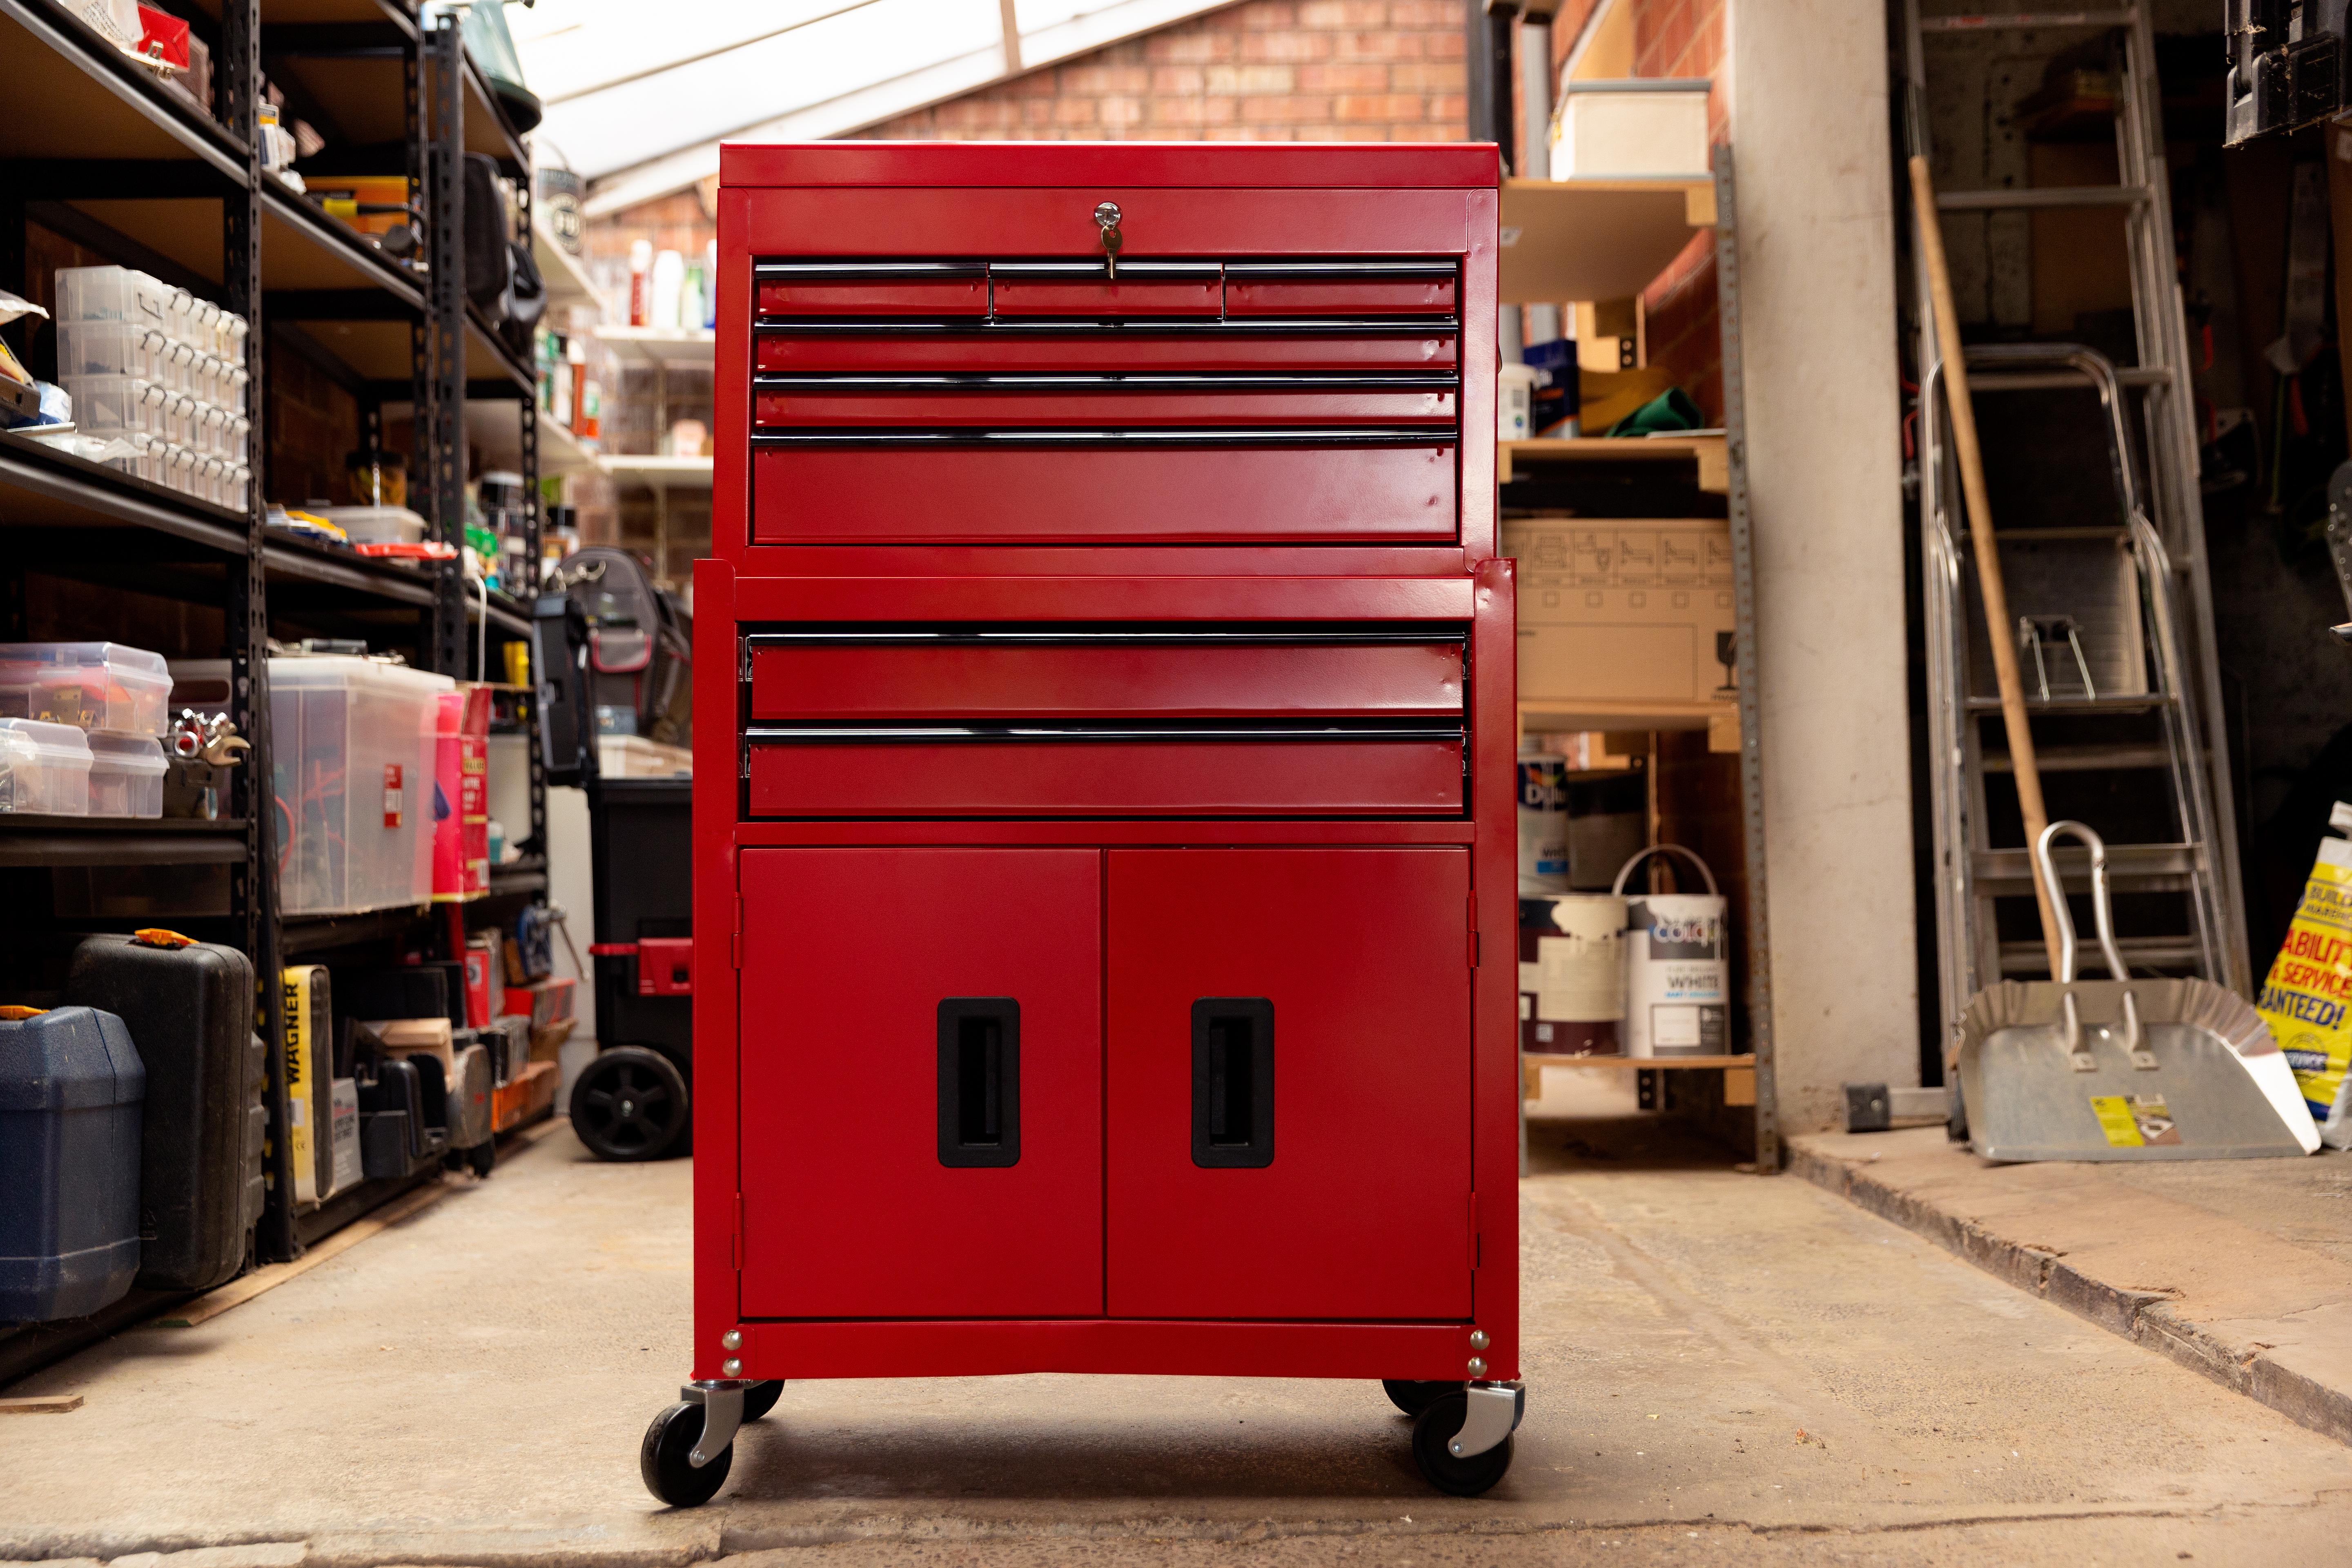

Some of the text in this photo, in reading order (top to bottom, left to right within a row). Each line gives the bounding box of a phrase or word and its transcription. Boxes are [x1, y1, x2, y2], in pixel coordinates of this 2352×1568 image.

[2281, 928, 2352, 971] ABILIT
[2284, 961, 2352, 998] SERVICE
[285, 982, 300, 1085] WAGNER
